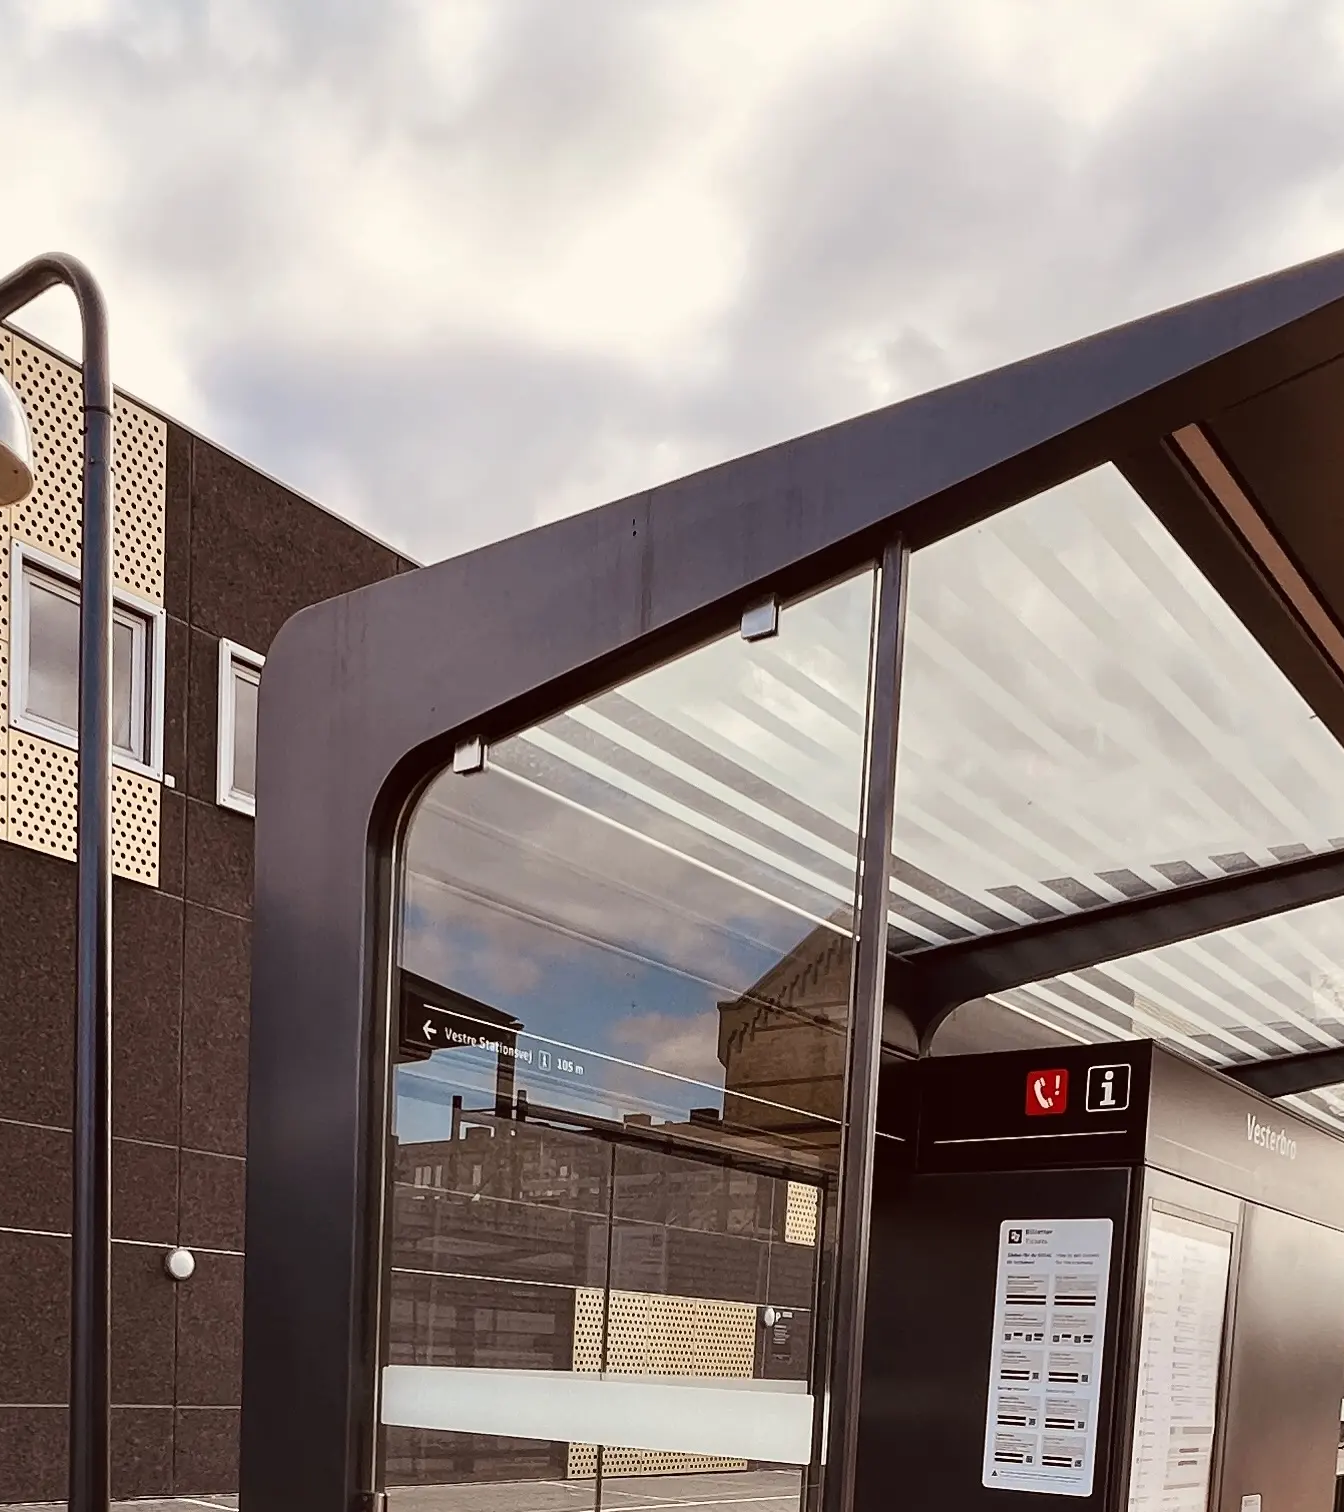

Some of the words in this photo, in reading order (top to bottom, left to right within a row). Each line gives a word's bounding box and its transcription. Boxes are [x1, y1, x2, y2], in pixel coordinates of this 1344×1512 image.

[444, 1026, 477, 1047] Vestre
[478, 1037, 533, 1065] Stationsvej
[556, 1057, 574, 1072] 105
[575, 1065, 584, 1075] m
[1245, 1111, 1297, 1160] Vesterbro
